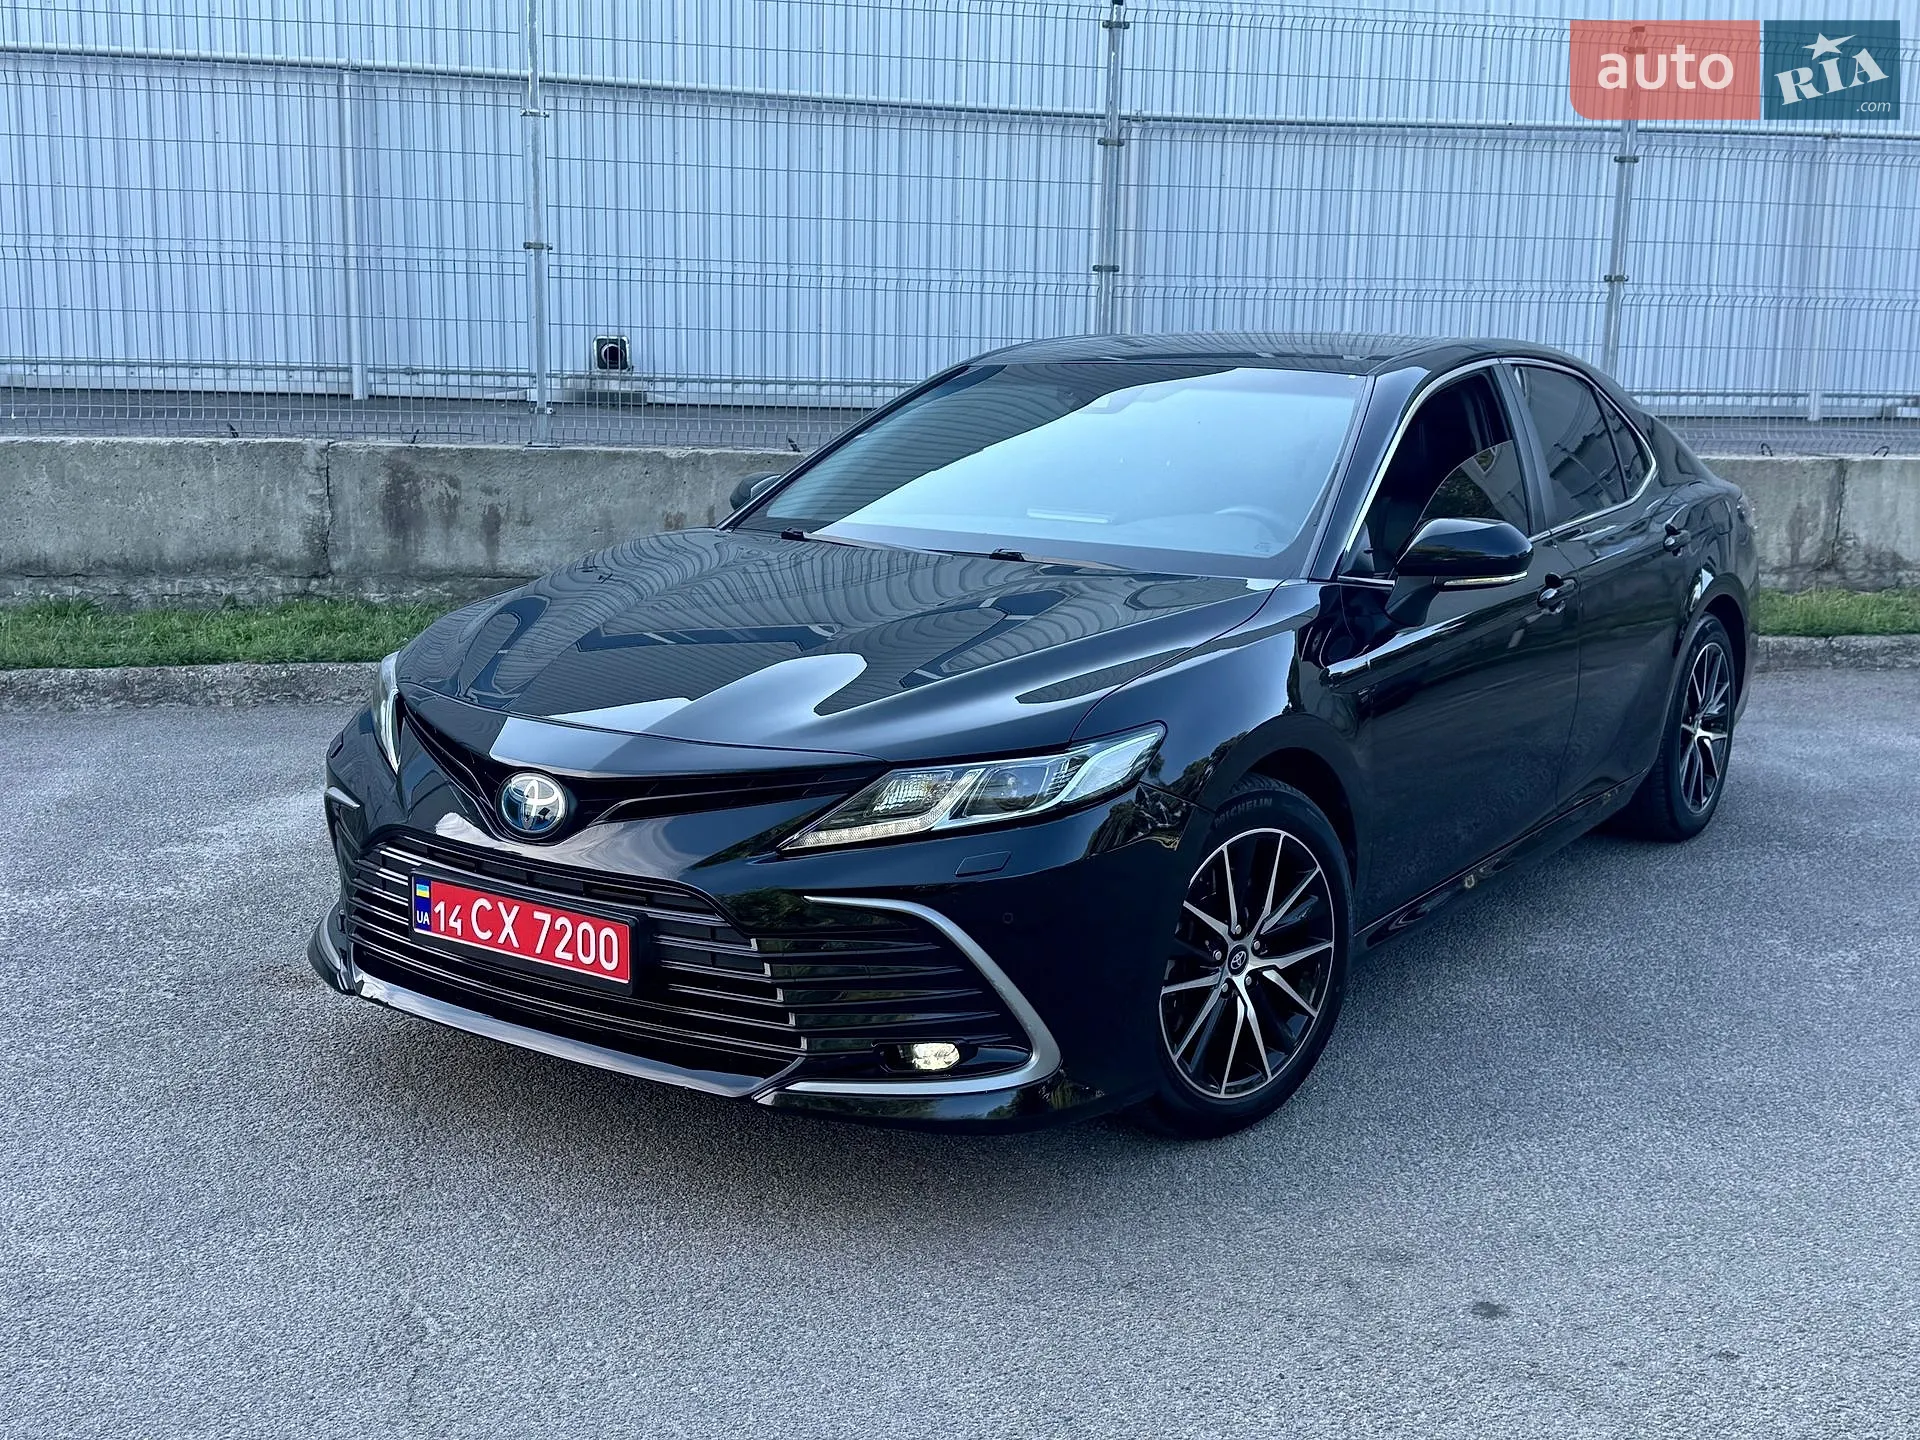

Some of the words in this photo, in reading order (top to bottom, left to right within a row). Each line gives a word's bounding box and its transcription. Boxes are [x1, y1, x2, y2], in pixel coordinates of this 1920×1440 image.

[416, 910, 430, 926] UA
[433, 901, 462, 936] 14
[471, 898, 520, 948] CX
[533, 911, 619, 971] 7200
